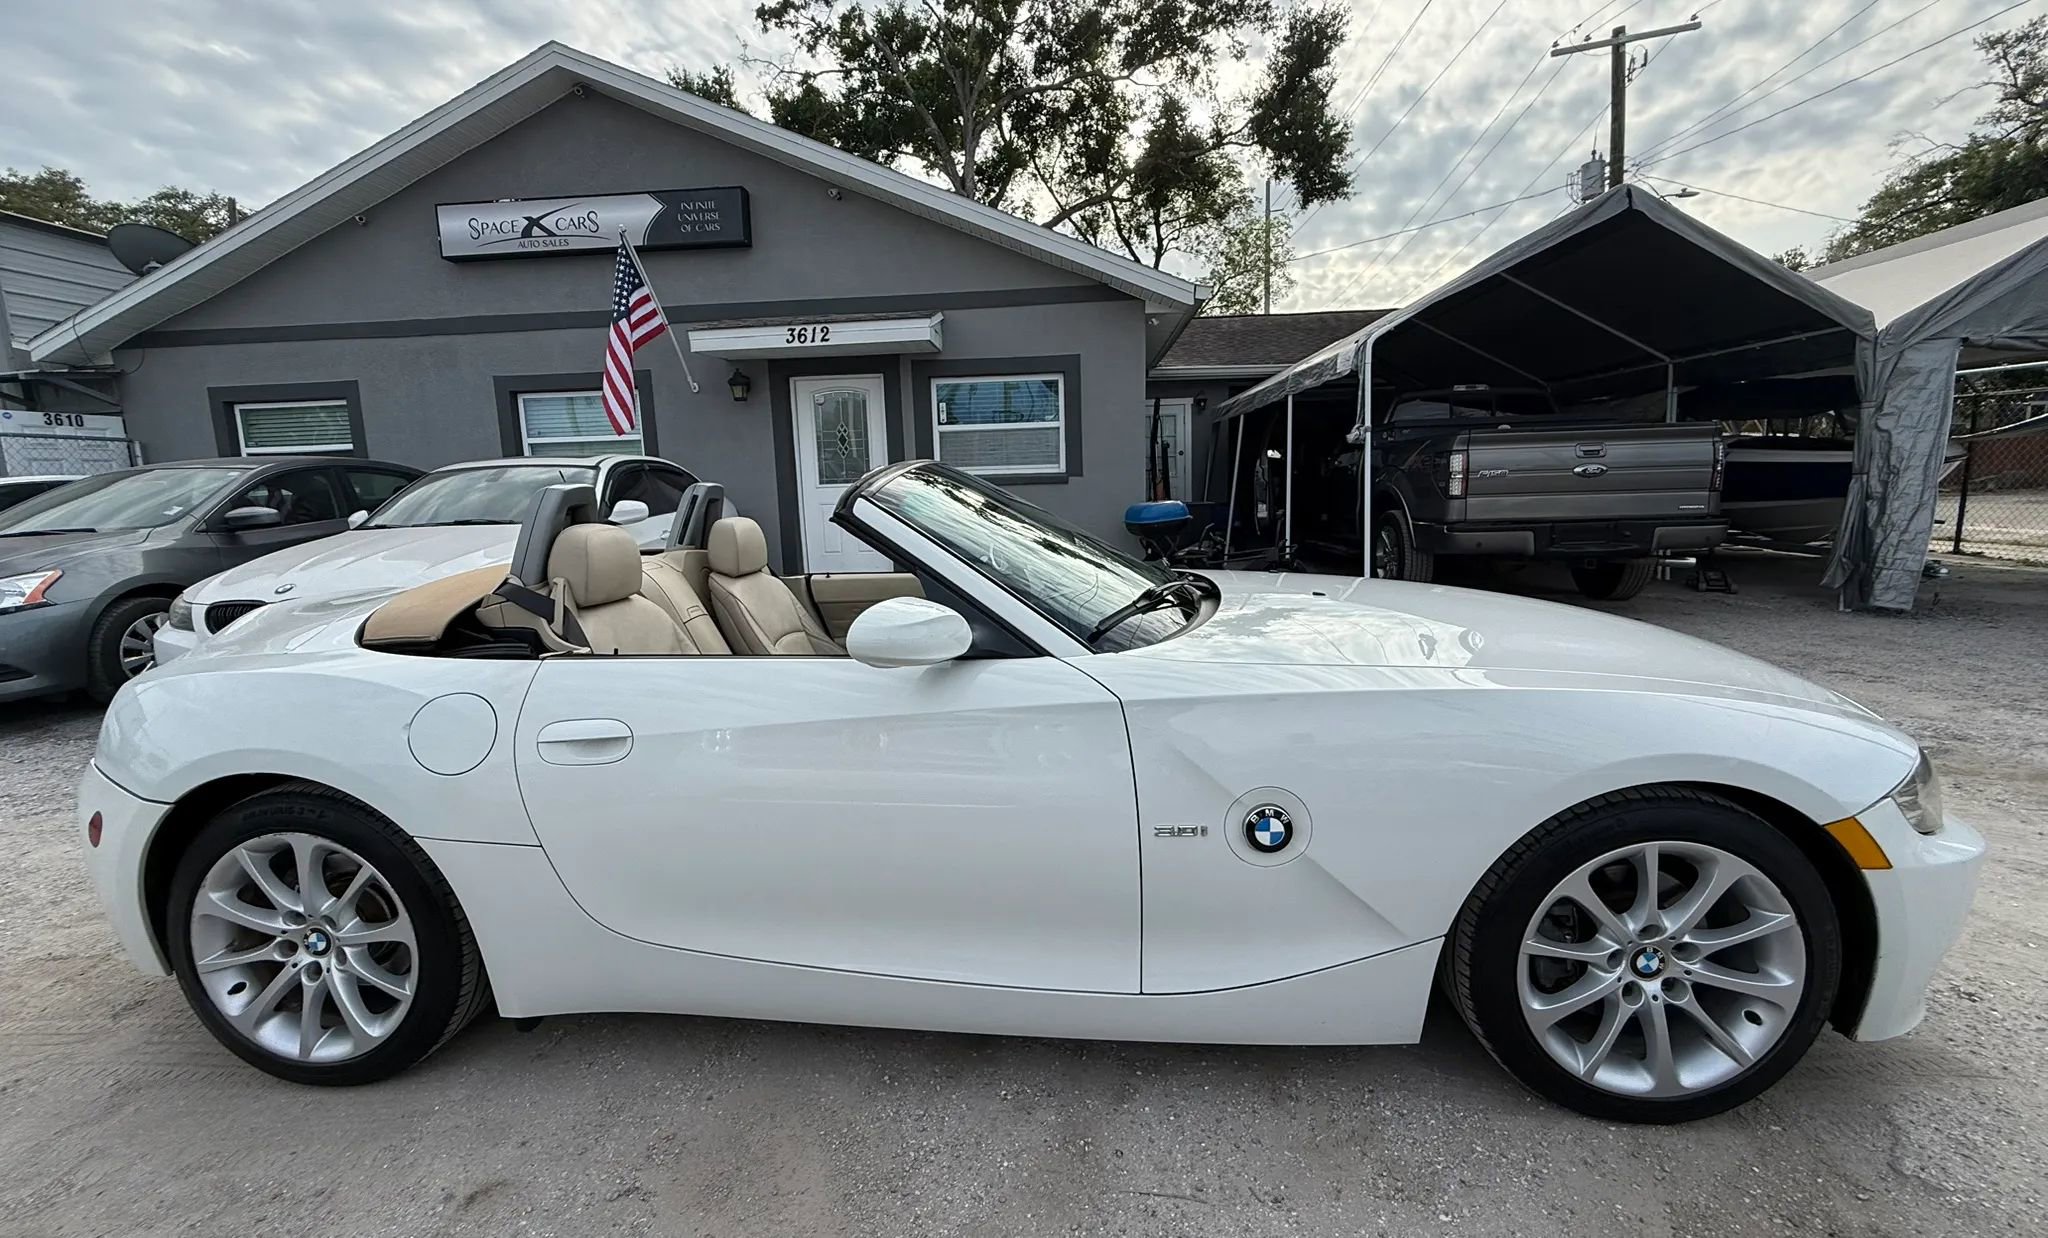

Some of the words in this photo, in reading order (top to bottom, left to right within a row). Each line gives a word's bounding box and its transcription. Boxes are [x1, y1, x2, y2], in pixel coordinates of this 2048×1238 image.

[680, 200, 716, 211] INFINITE
[677, 211, 720, 222] UNIVERSE
[468, 217, 520, 240] SPACE
[555, 210, 600, 234] CARS
[680, 224, 692, 233] OF
[695, 222, 721, 232] CARS
[518, 239, 541, 249] AUTO
[543, 238, 570, 248] SALES
[785, 325, 830, 344] 3612
[43, 412, 84, 427] 3610
[1250, 808, 1290, 825] BMW
